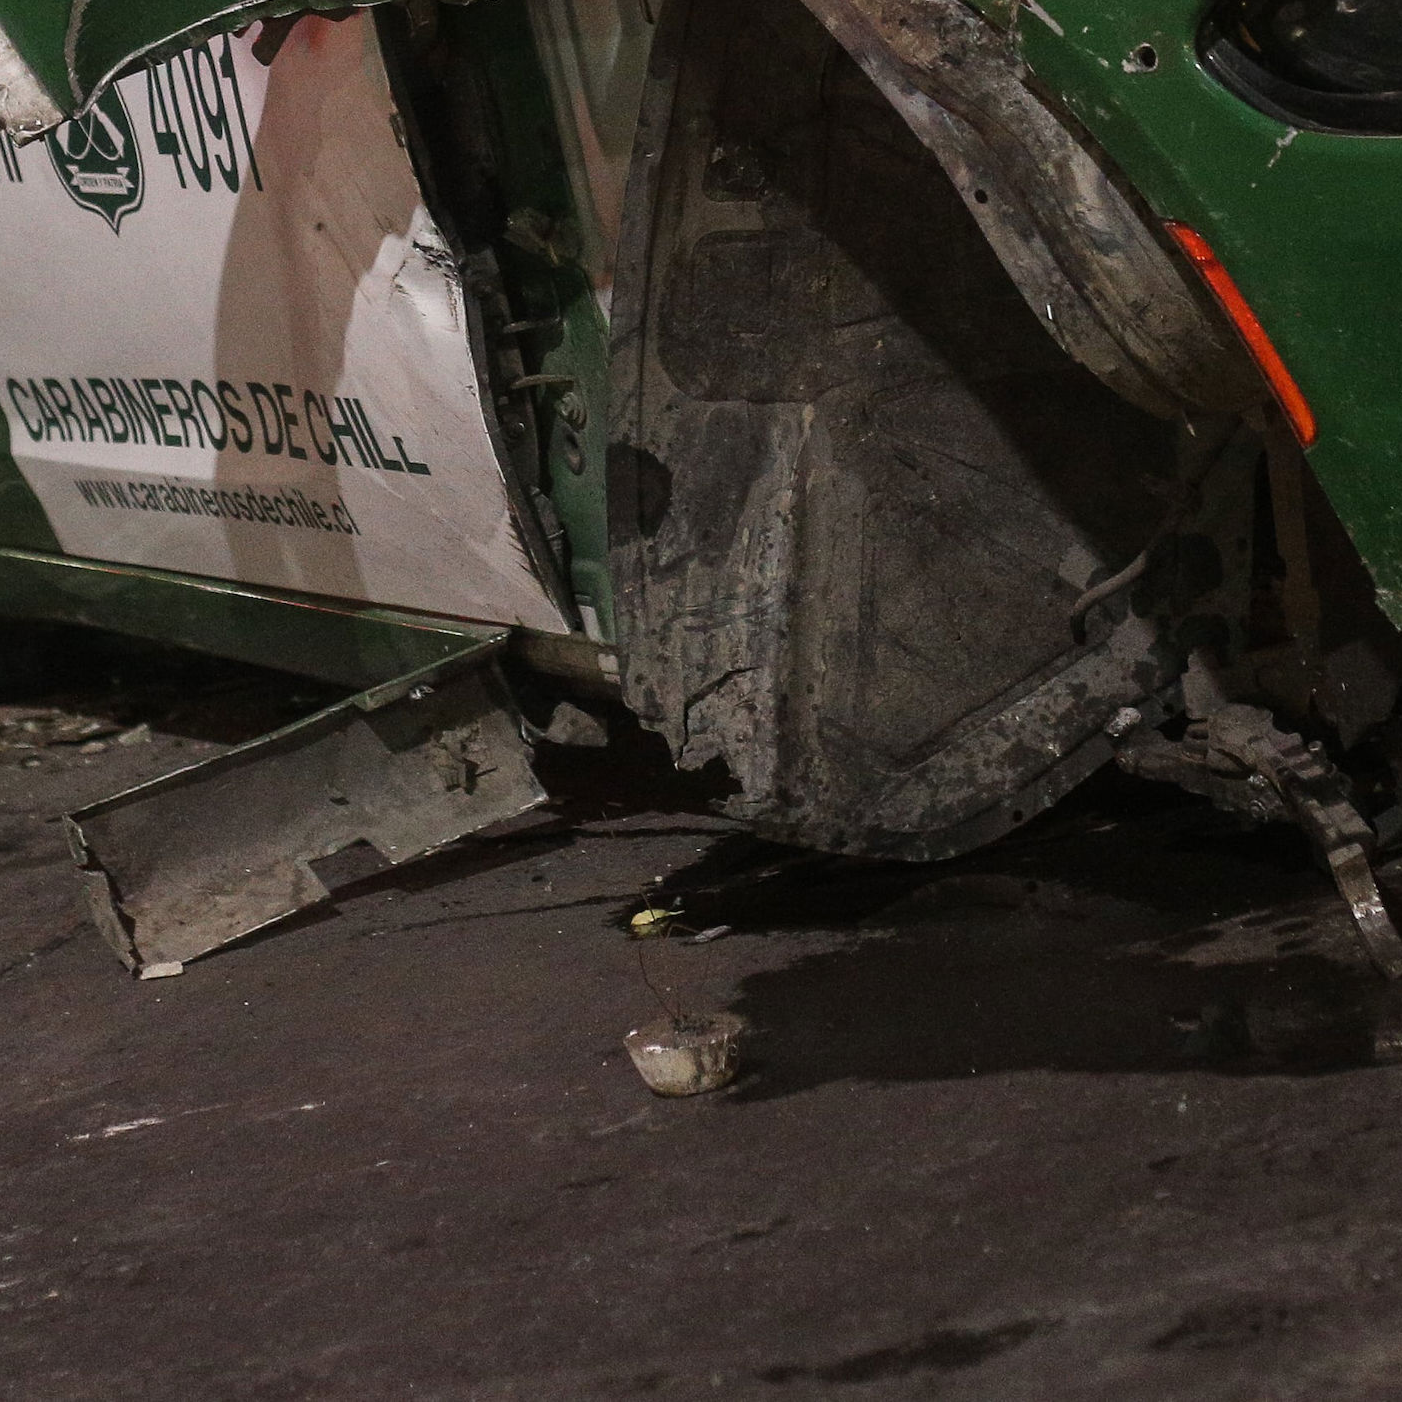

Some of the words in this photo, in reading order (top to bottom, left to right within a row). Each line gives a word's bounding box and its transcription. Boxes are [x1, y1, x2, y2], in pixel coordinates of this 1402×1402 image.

[146, 31, 263, 193] 4091
[5, 377, 254, 455] CARABINEROS
[245, 381, 308, 461] DE
[74, 476, 362, 536] www.carabinerosdechile.cl
